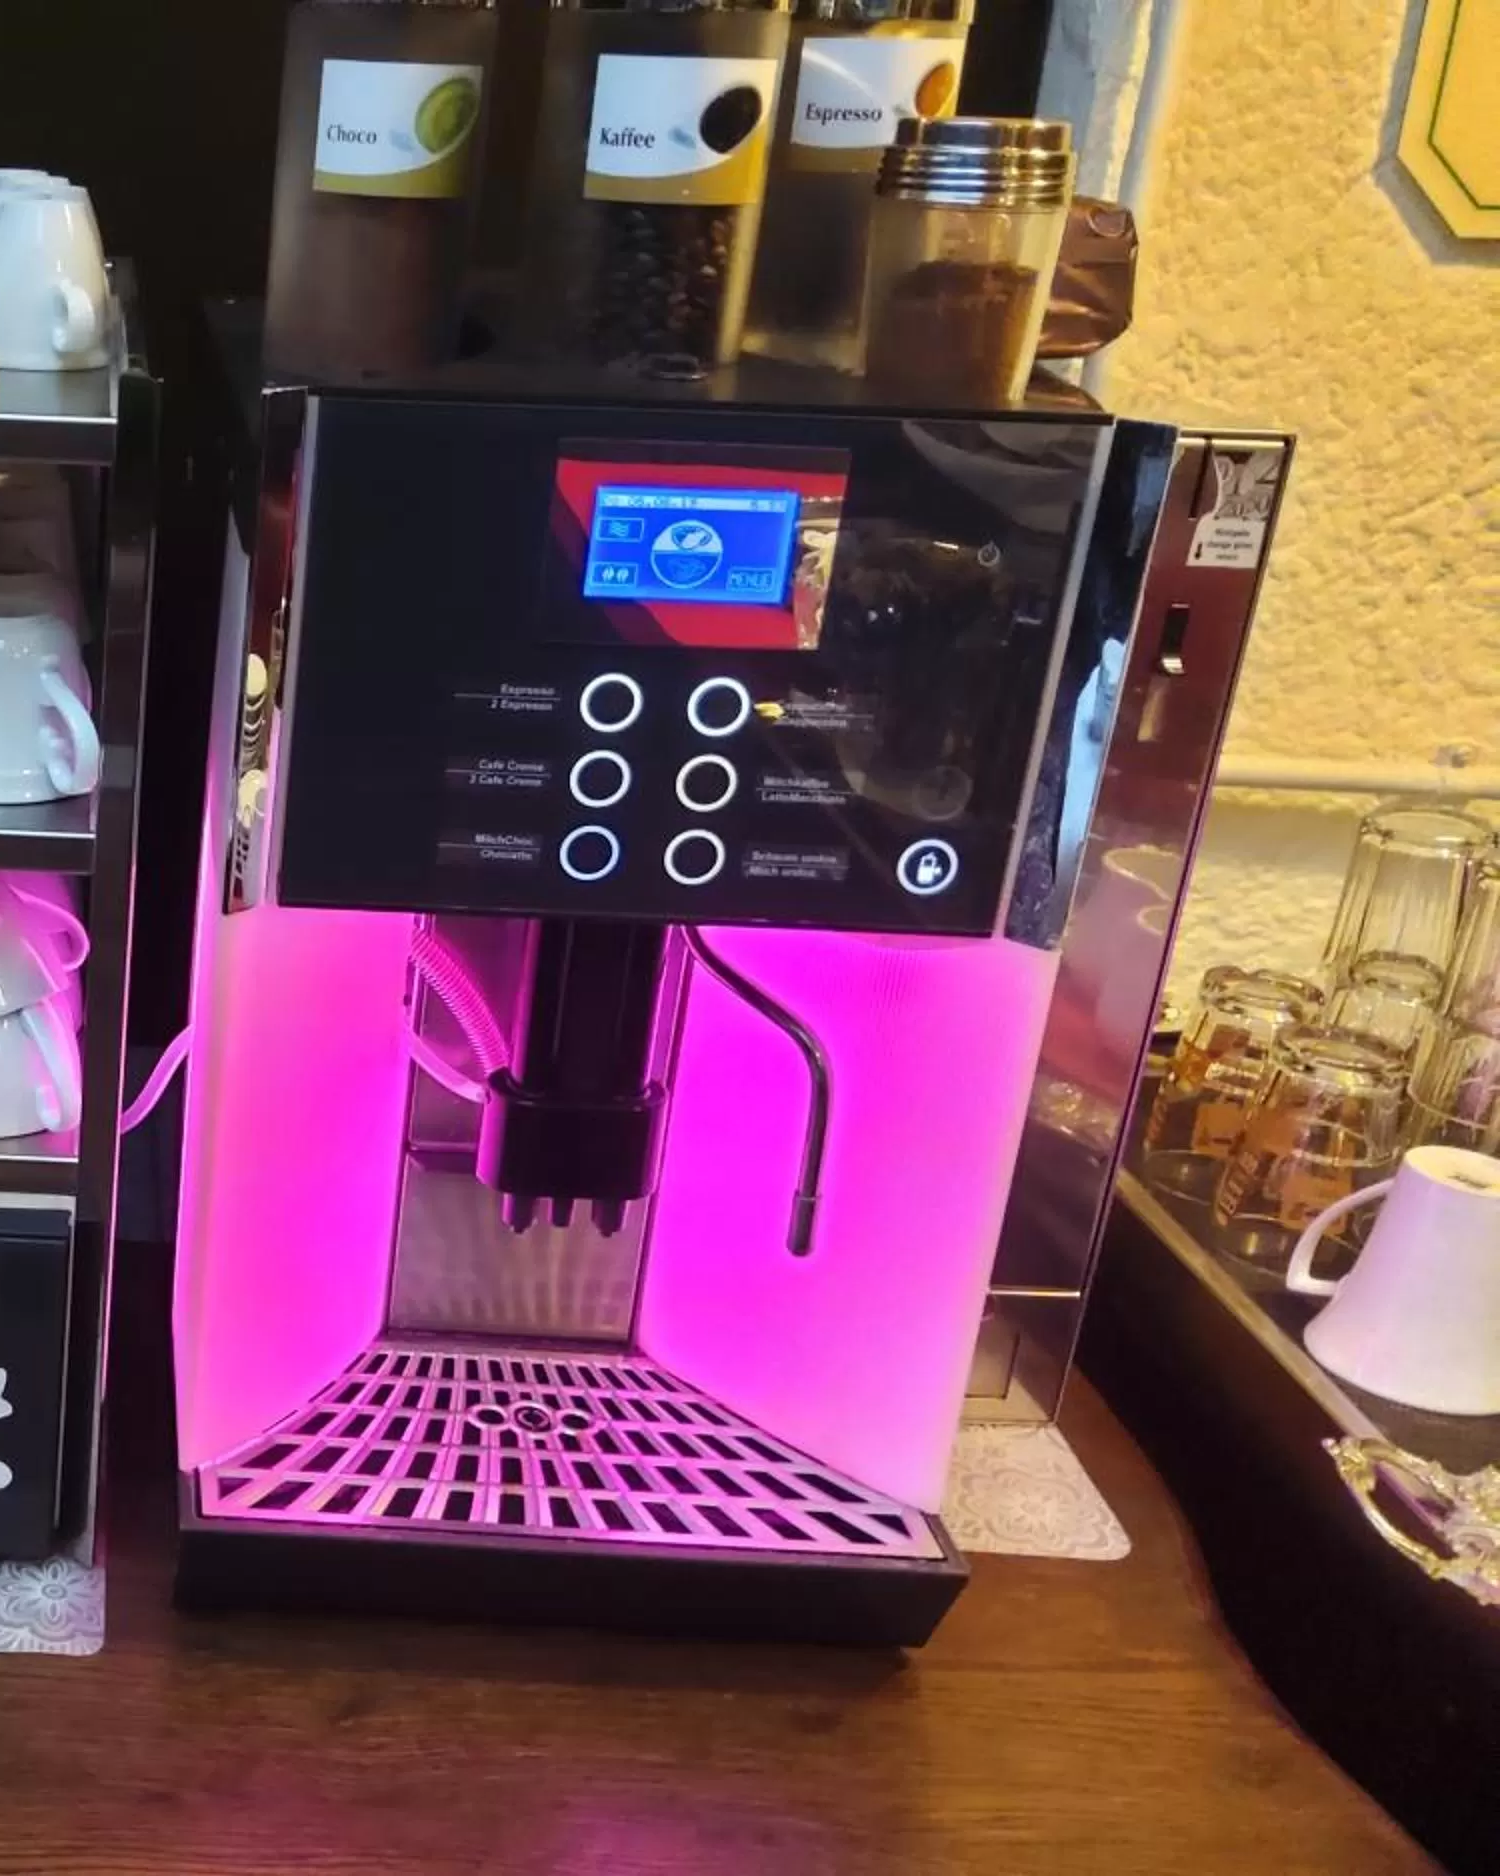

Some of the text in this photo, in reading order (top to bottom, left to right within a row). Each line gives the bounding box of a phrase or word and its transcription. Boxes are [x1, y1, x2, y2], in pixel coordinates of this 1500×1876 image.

[803, 102, 884, 126] Espresso
[325, 123, 378, 146] Choco
[598, 126, 656, 150] Kaffee
